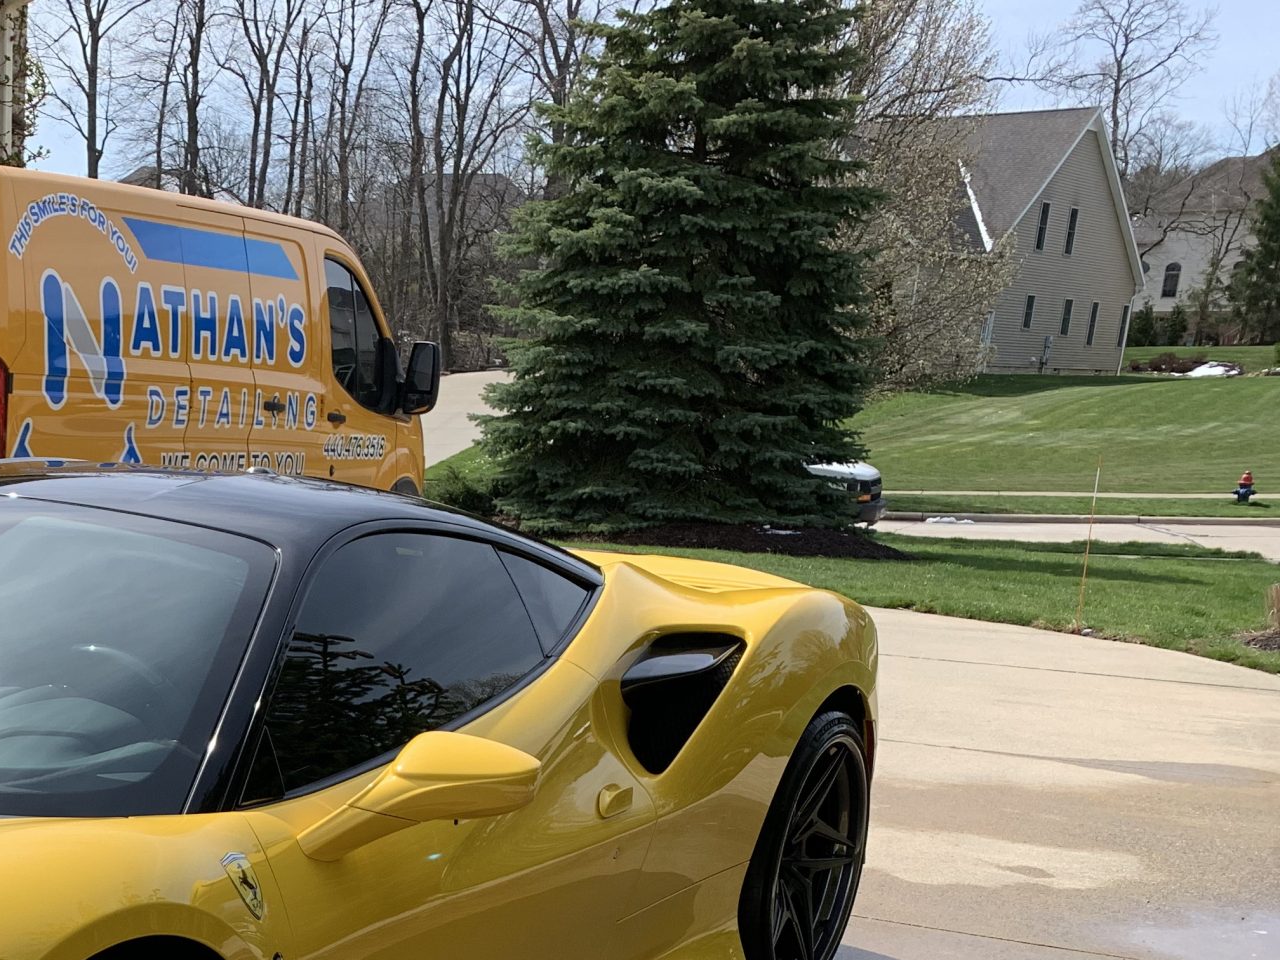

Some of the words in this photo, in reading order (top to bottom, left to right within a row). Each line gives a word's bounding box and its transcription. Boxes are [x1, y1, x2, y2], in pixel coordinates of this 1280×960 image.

[9, 215, 32, 257] THIS
[29, 194, 78, 224] SMILE'S
[80, 199, 107, 233] FOR
[109, 221, 138, 272] YOU!
[147, 388, 317, 429] DETAILING
[195, 453, 246, 470] COME
[251, 453, 270, 469] TO
[275, 453, 305, 475] YOU
